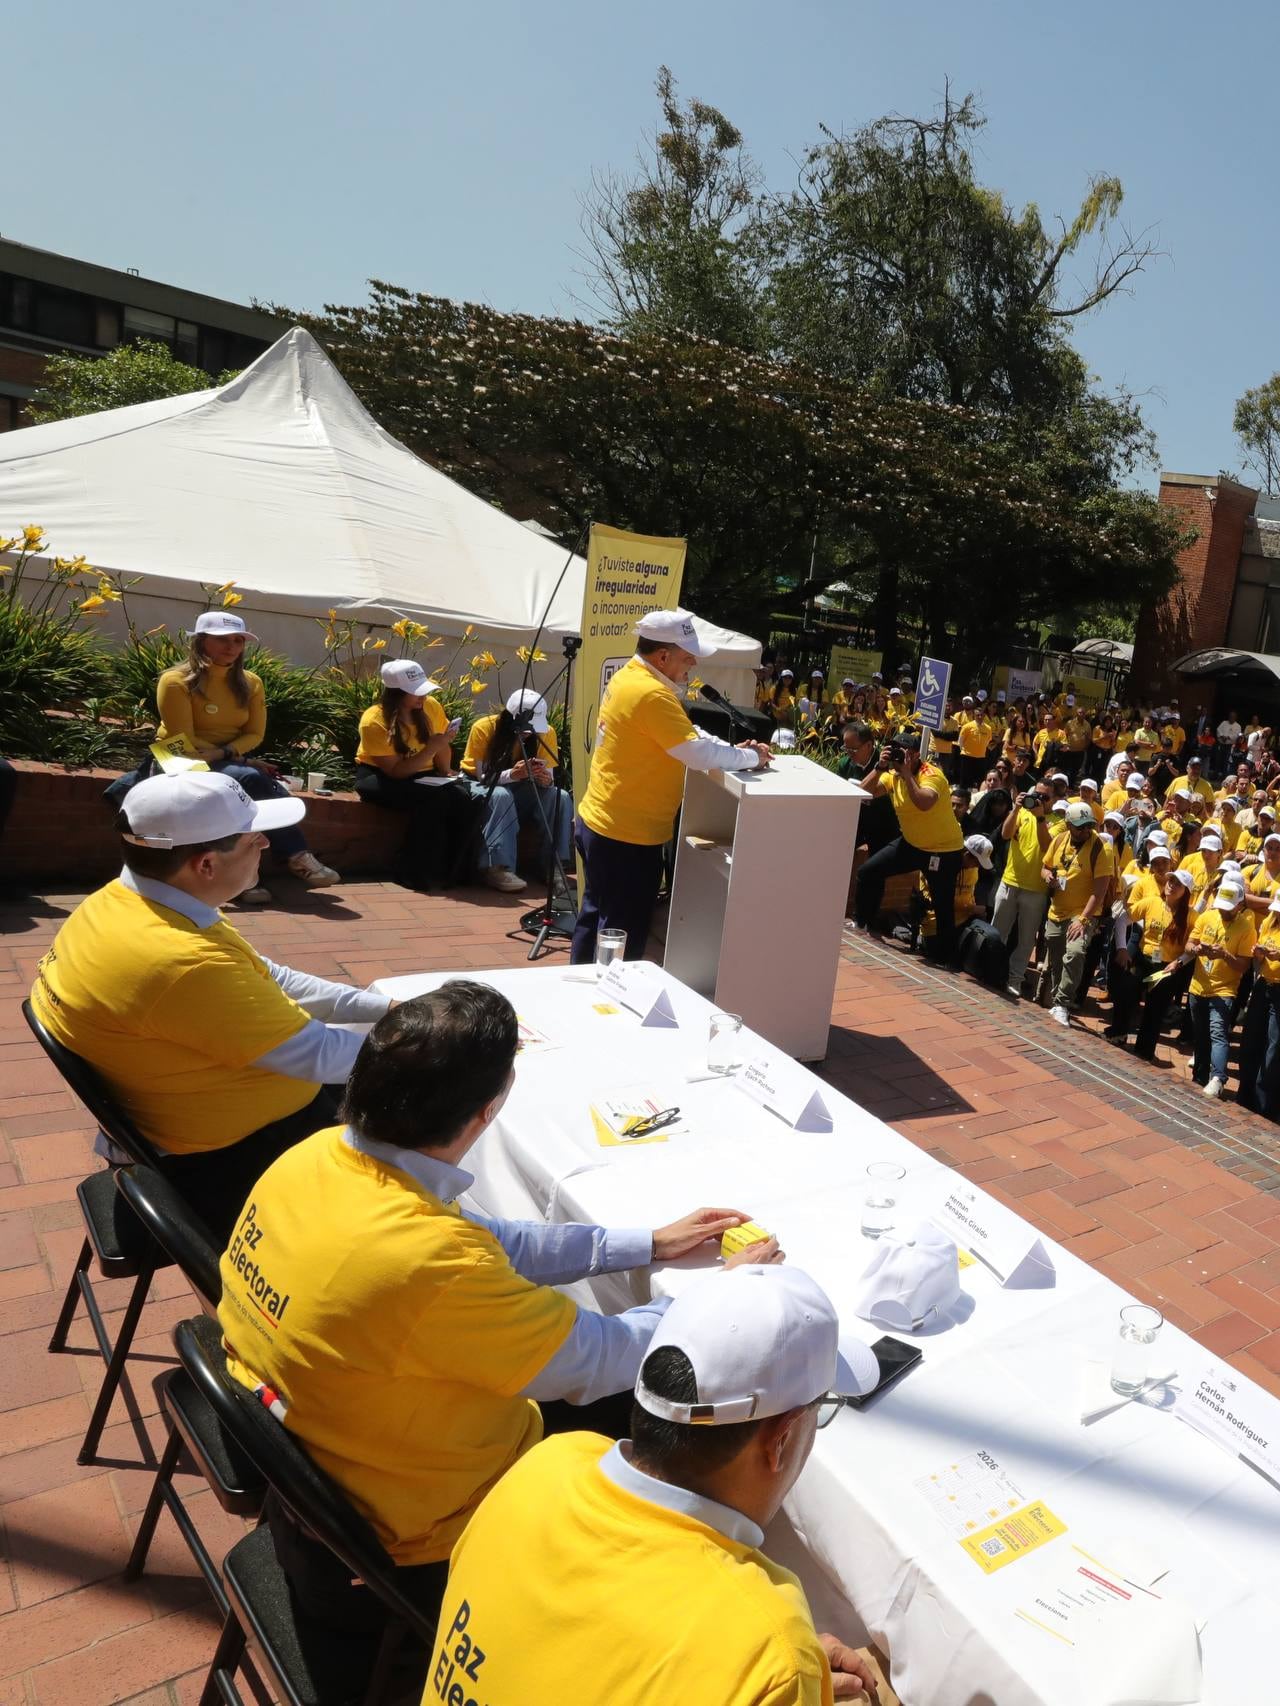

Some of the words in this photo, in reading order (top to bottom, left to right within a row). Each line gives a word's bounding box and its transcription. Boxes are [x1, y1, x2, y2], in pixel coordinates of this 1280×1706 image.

[598, 556, 635, 573] ¿Tuviste
[635, 562, 669, 578] alguna
[595, 576, 657, 597] irregularidad
[592, 605, 598, 614] o
[590, 623, 599, 637] al
[600, 623, 628, 637] votar?
[240, 1202, 264, 1251] Paz
[229, 1235, 290, 1321] Electoral
[1200, 1380, 1226, 1404] Carlos
[977, 1450, 999, 1471] 2026
[1035, 1598, 1068, 1620] Elecciones
[446, 1599, 486, 1683] Paz
